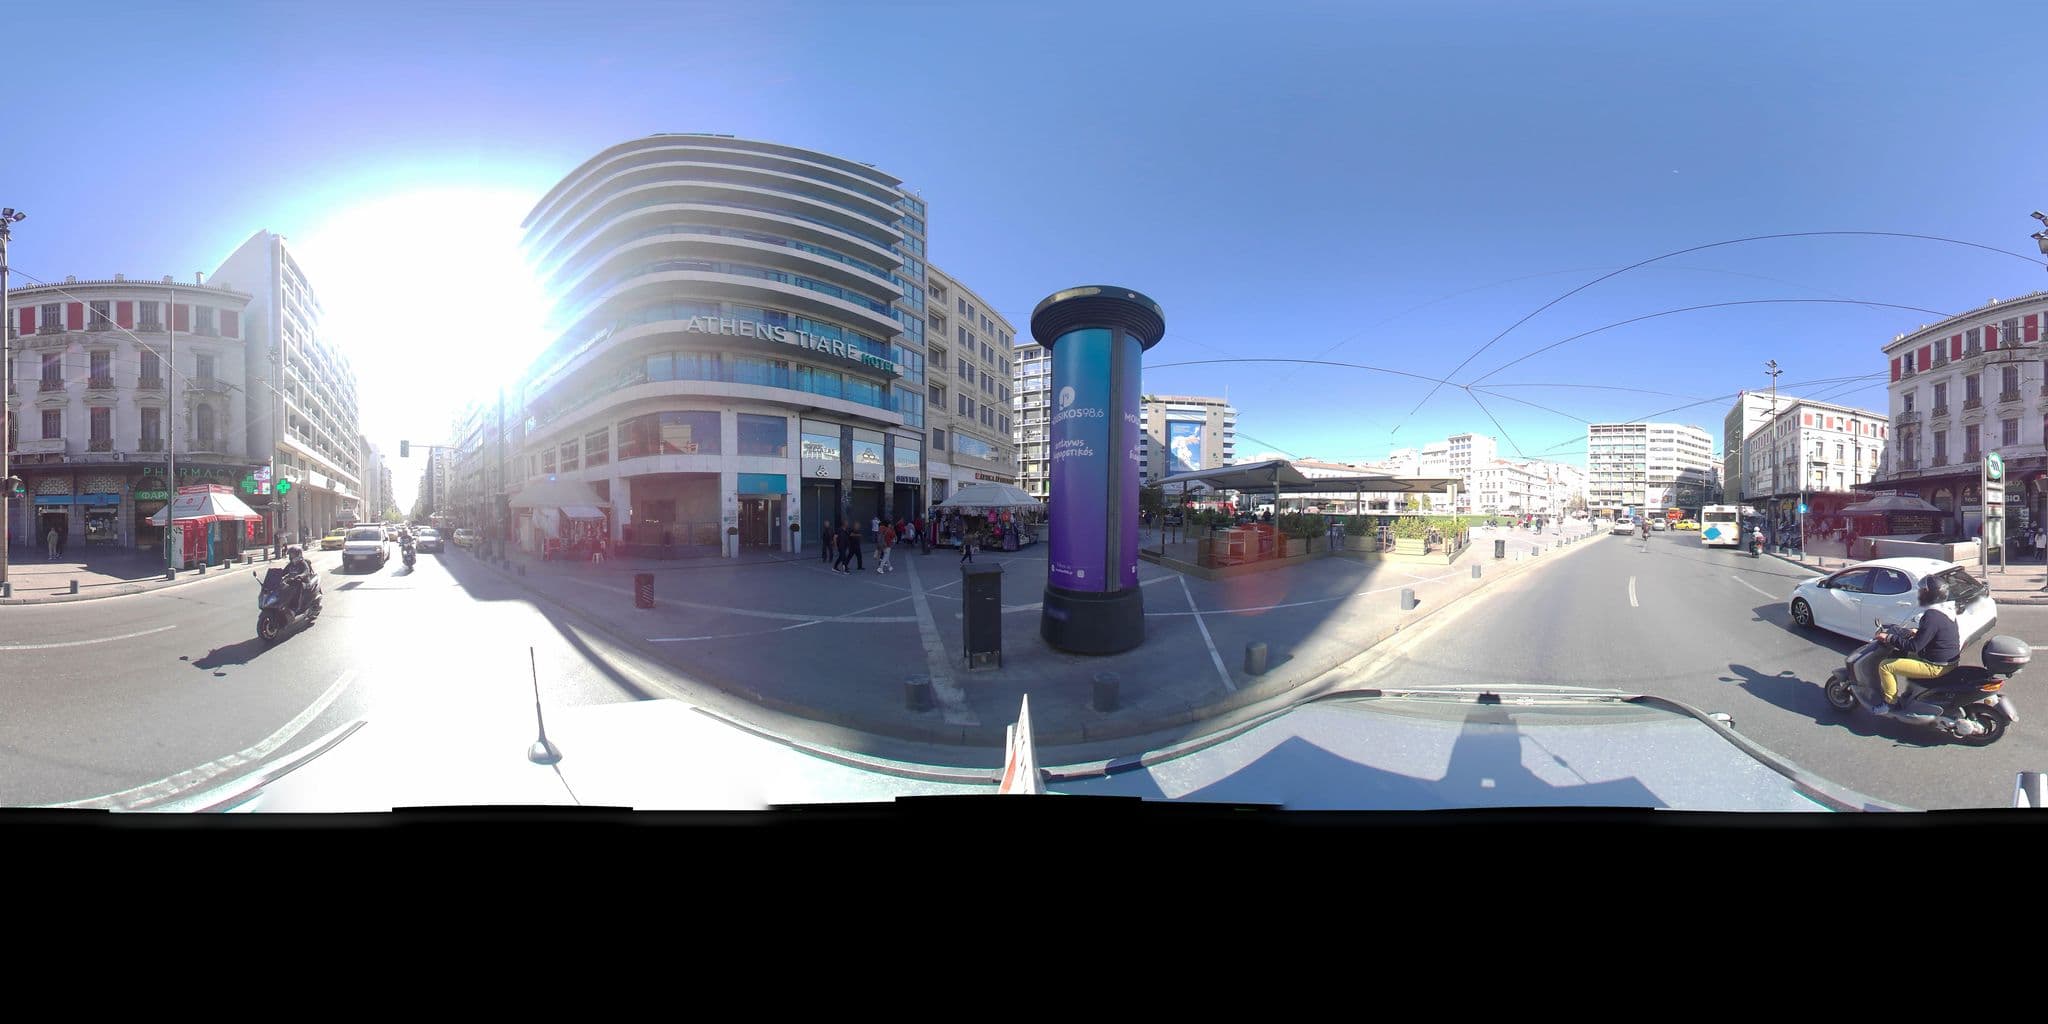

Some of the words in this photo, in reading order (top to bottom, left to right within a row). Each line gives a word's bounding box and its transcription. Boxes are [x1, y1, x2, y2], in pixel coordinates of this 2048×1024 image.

[686, 315, 788, 343] ATHENS
[795, 329, 860, 360] TIARE
[861, 354, 896, 373] HOTEL
